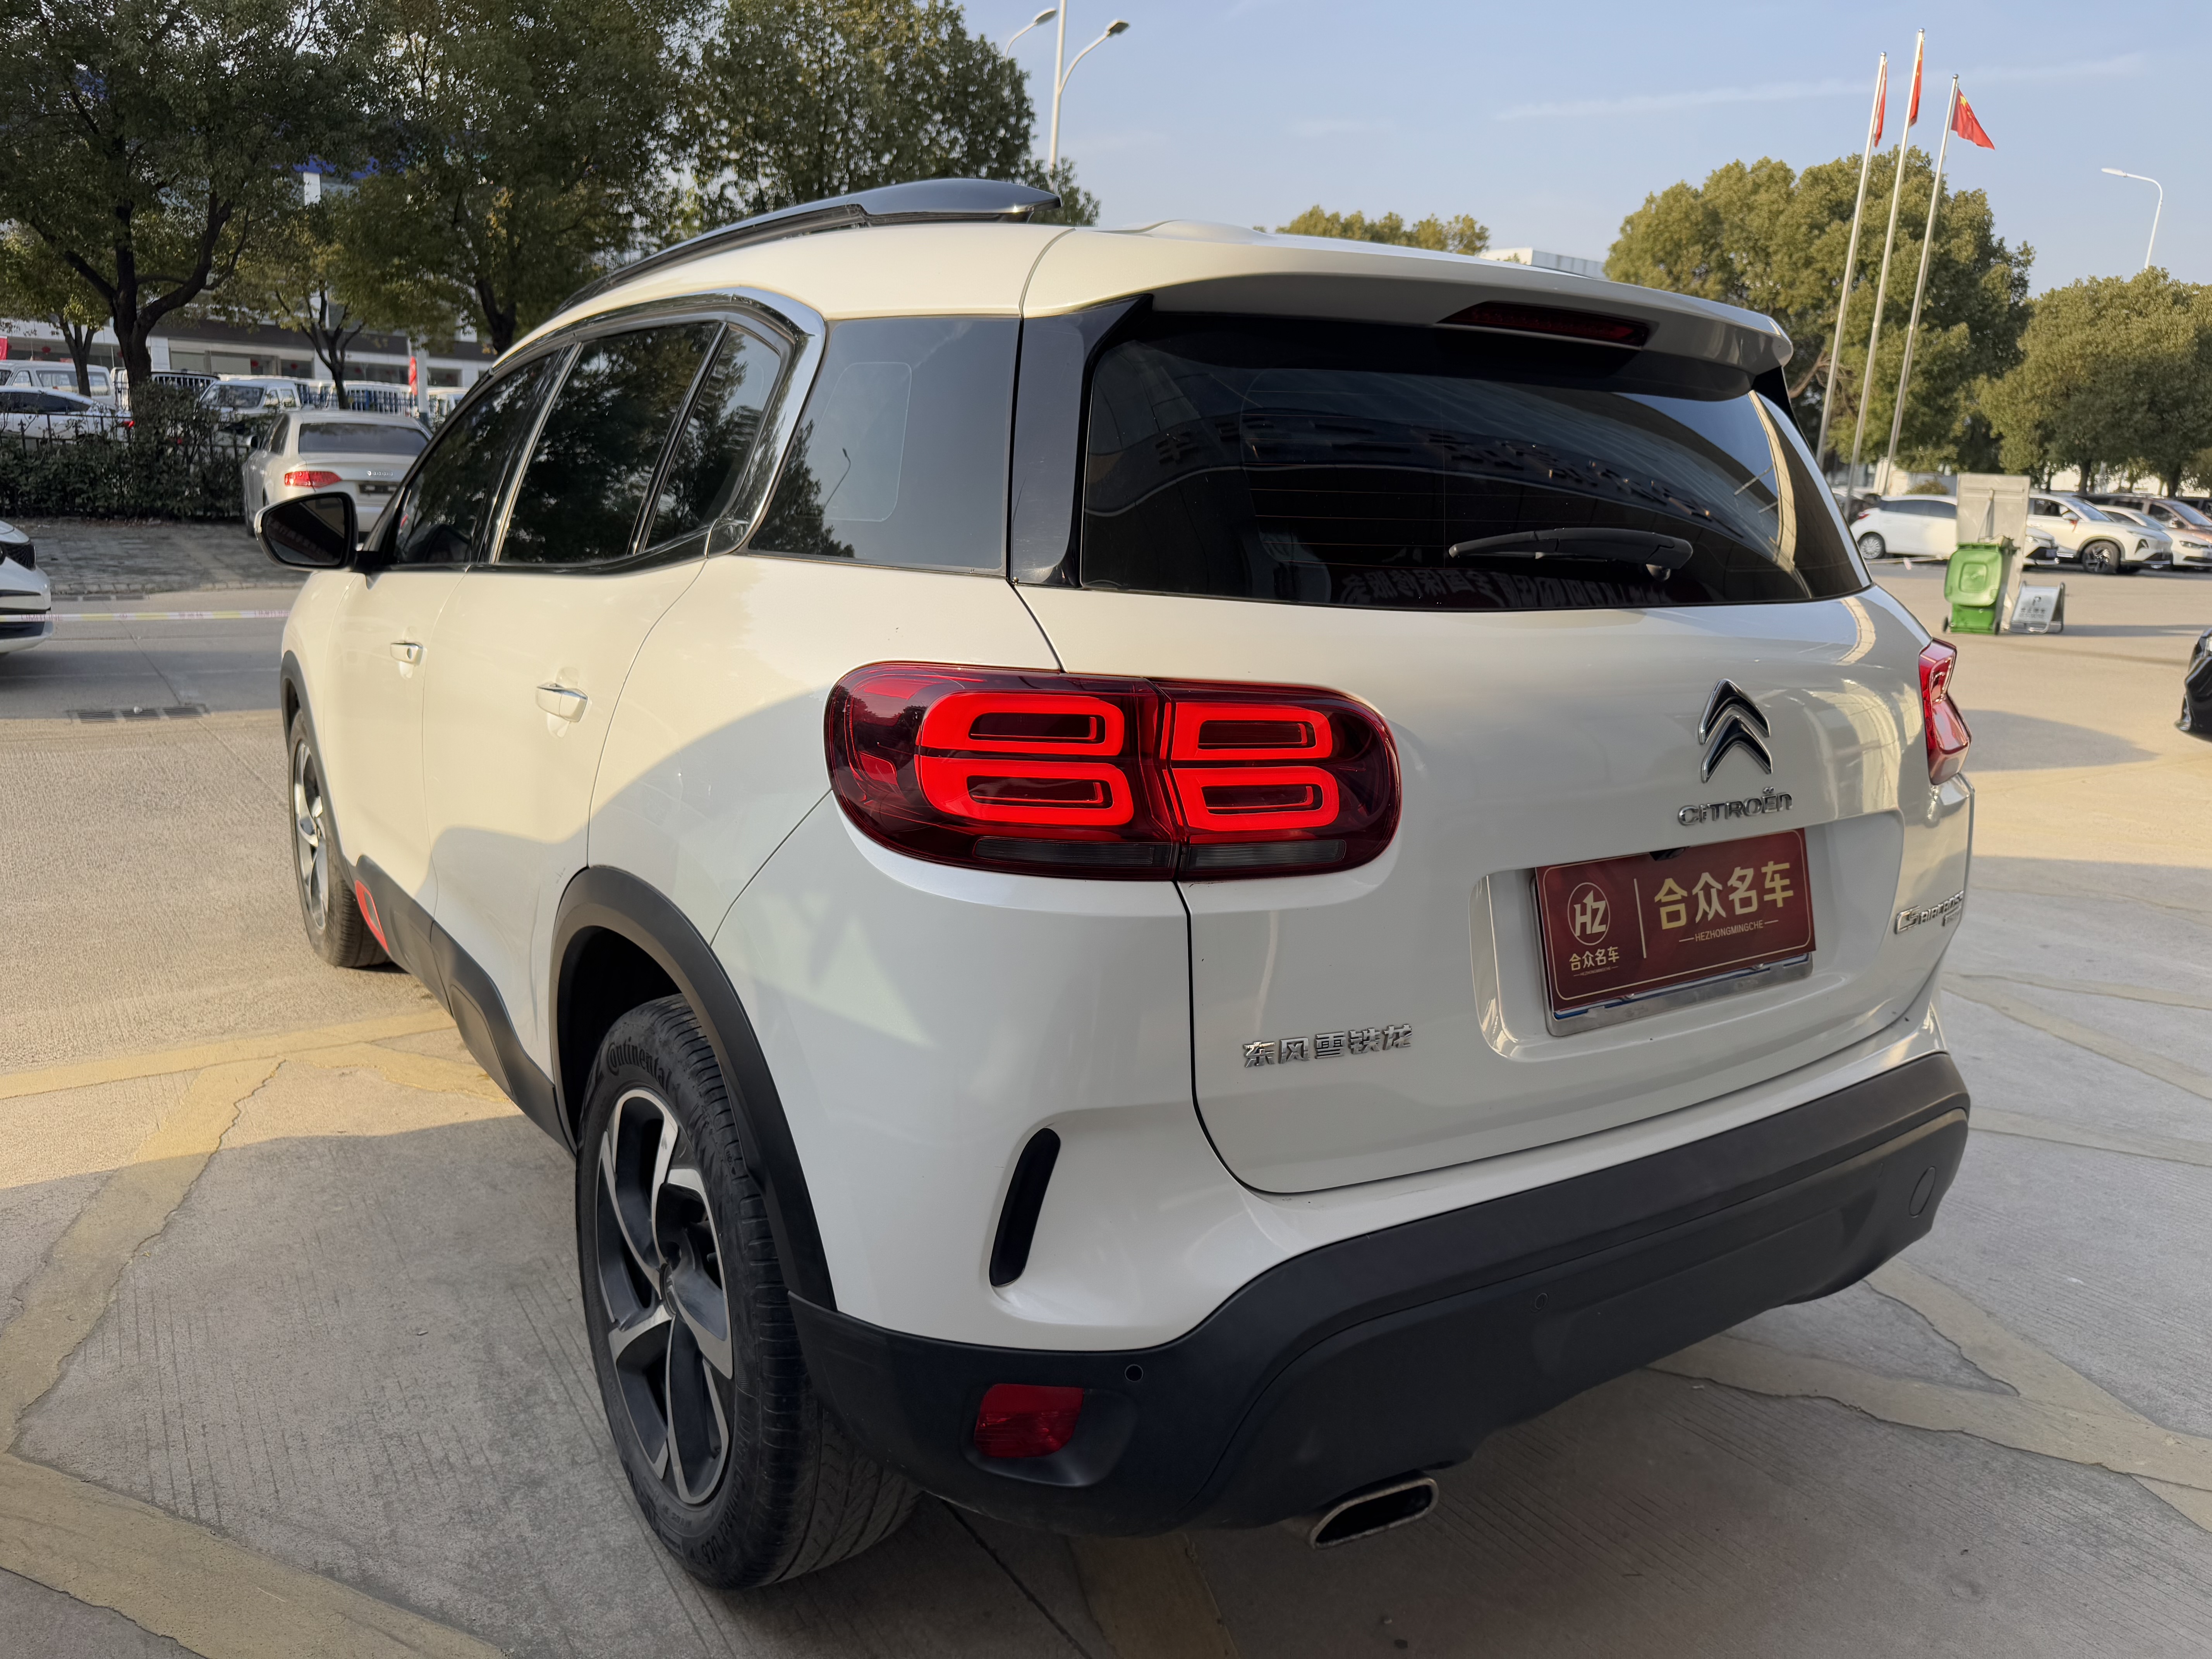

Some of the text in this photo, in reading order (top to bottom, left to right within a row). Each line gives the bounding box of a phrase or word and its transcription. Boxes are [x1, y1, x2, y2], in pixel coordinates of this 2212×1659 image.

[1654, 861, 1794, 929] 合众名车
[1695, 919, 1764, 943] HEZHONGMINGCHE
[1569, 946, 1620, 971] 合众名车
[606, 1036, 672, 1095] Continental
[1244, 1023, 1413, 1068] 东风雪铁龙
